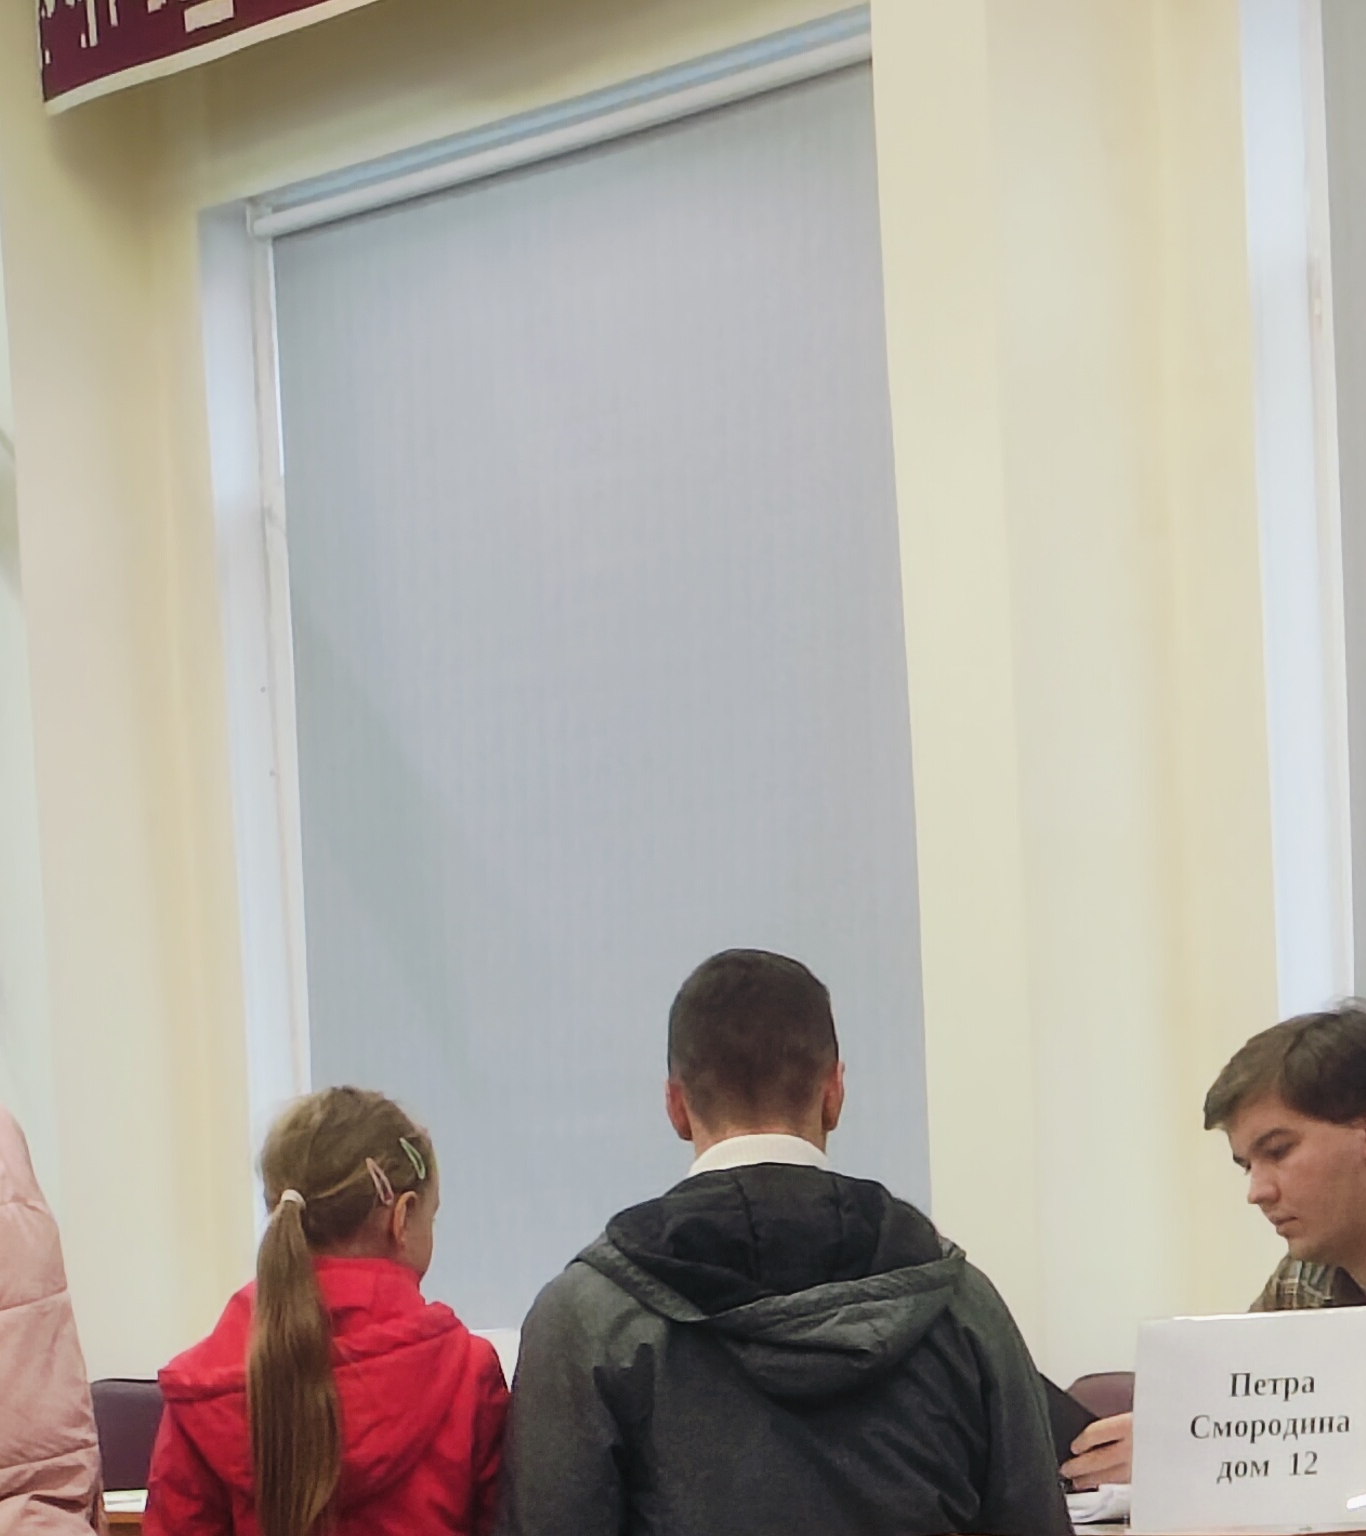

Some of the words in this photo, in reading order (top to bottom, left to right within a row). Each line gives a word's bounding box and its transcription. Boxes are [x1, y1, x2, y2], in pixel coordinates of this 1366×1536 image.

[1229, 1372, 1315, 1401] Петра
[1190, 1414, 1350, 1444] Смородина
[1216, 1459, 1270, 1484] дом
[1288, 1451, 1318, 1476] 12
